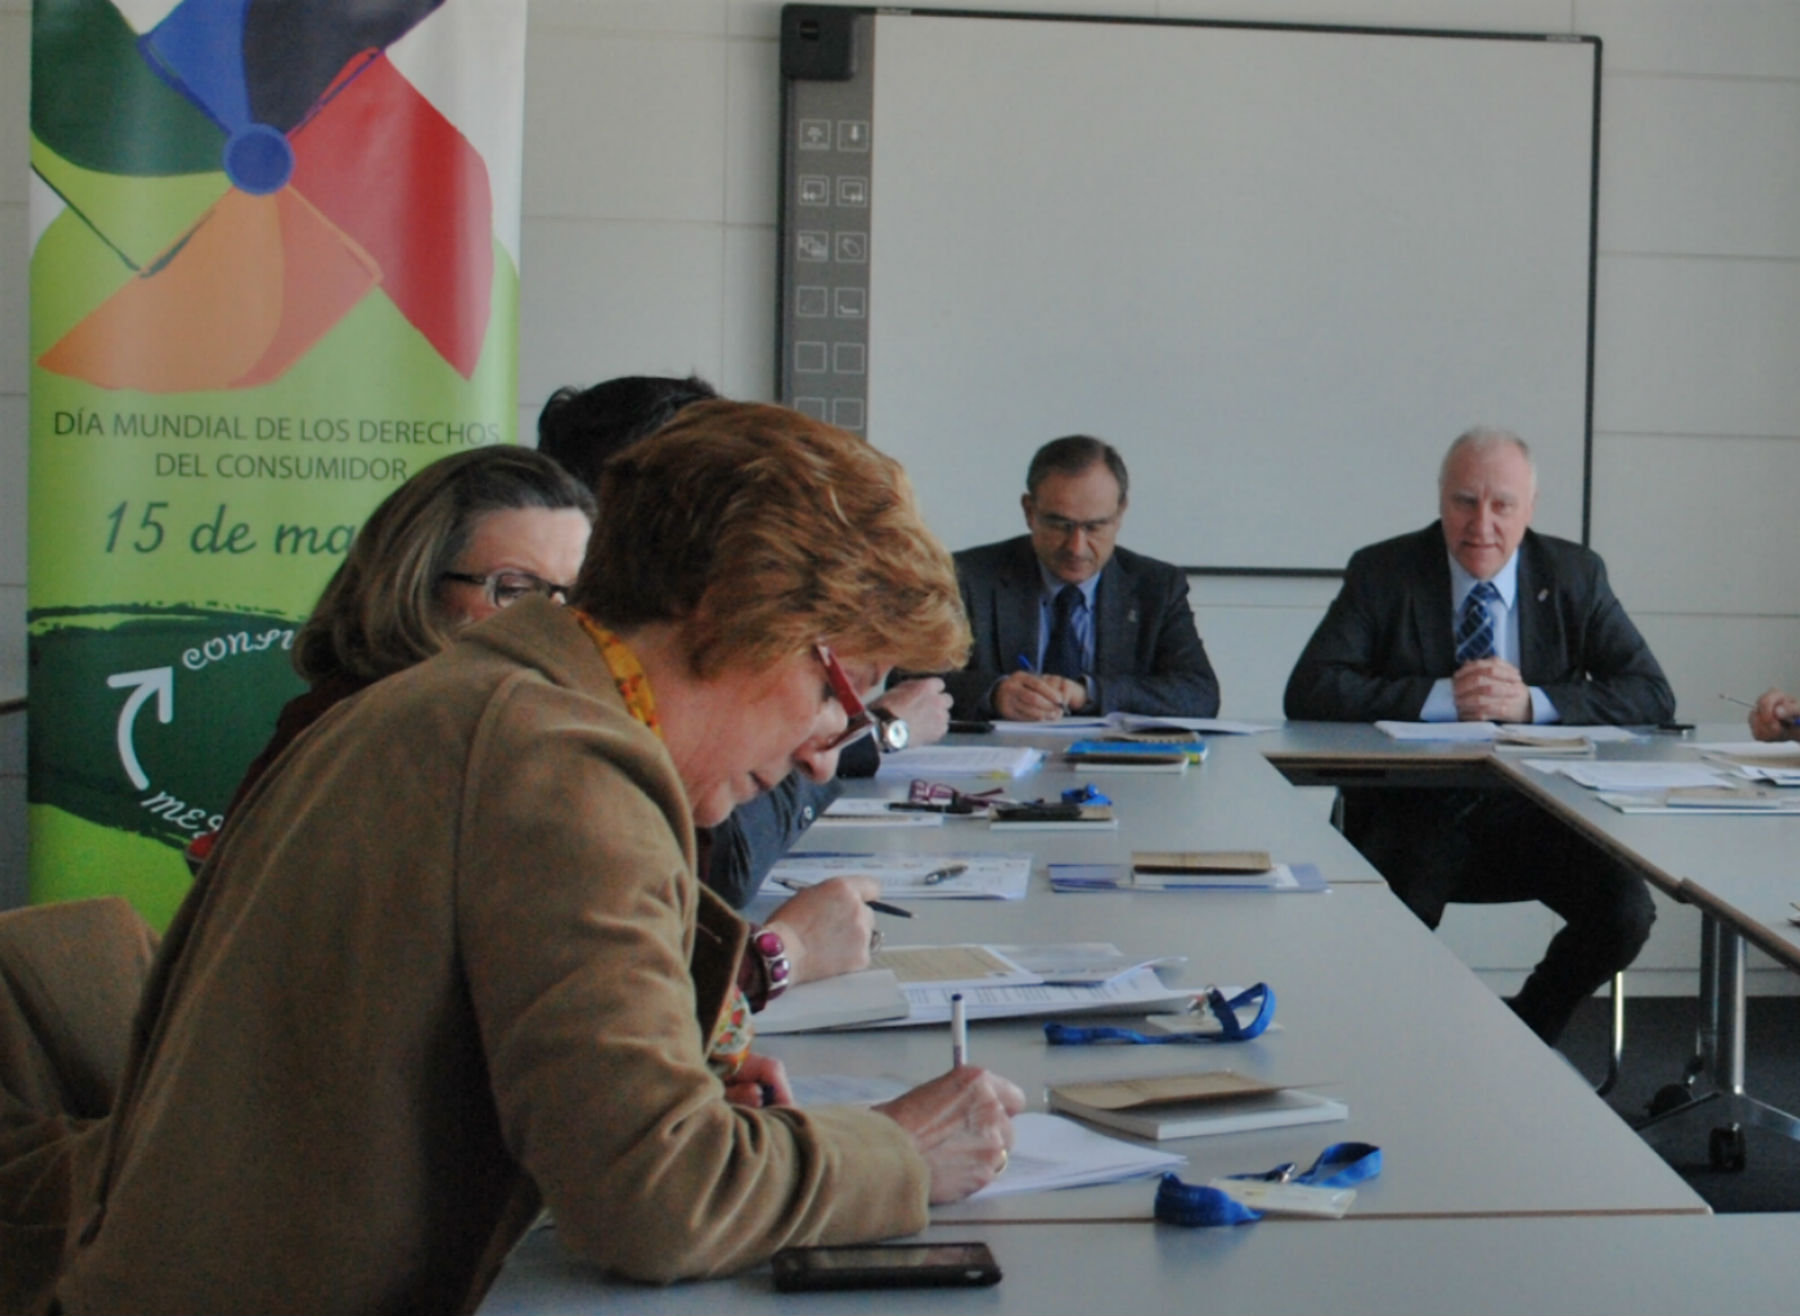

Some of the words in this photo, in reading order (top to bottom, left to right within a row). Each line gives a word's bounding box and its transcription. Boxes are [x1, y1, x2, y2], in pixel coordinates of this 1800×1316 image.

[54, 408, 104, 436] DÍA
[113, 413, 247, 439] MUNDIAL
[256, 417, 291, 441] DE
[300, 419, 350, 442] LOS
[358, 420, 499, 445] DERECHOS
[156, 453, 207, 478] DEL
[216, 454, 407, 480] CONSUMIDOR
[106, 500, 169, 554] 15
[190, 503, 256, 554] de
